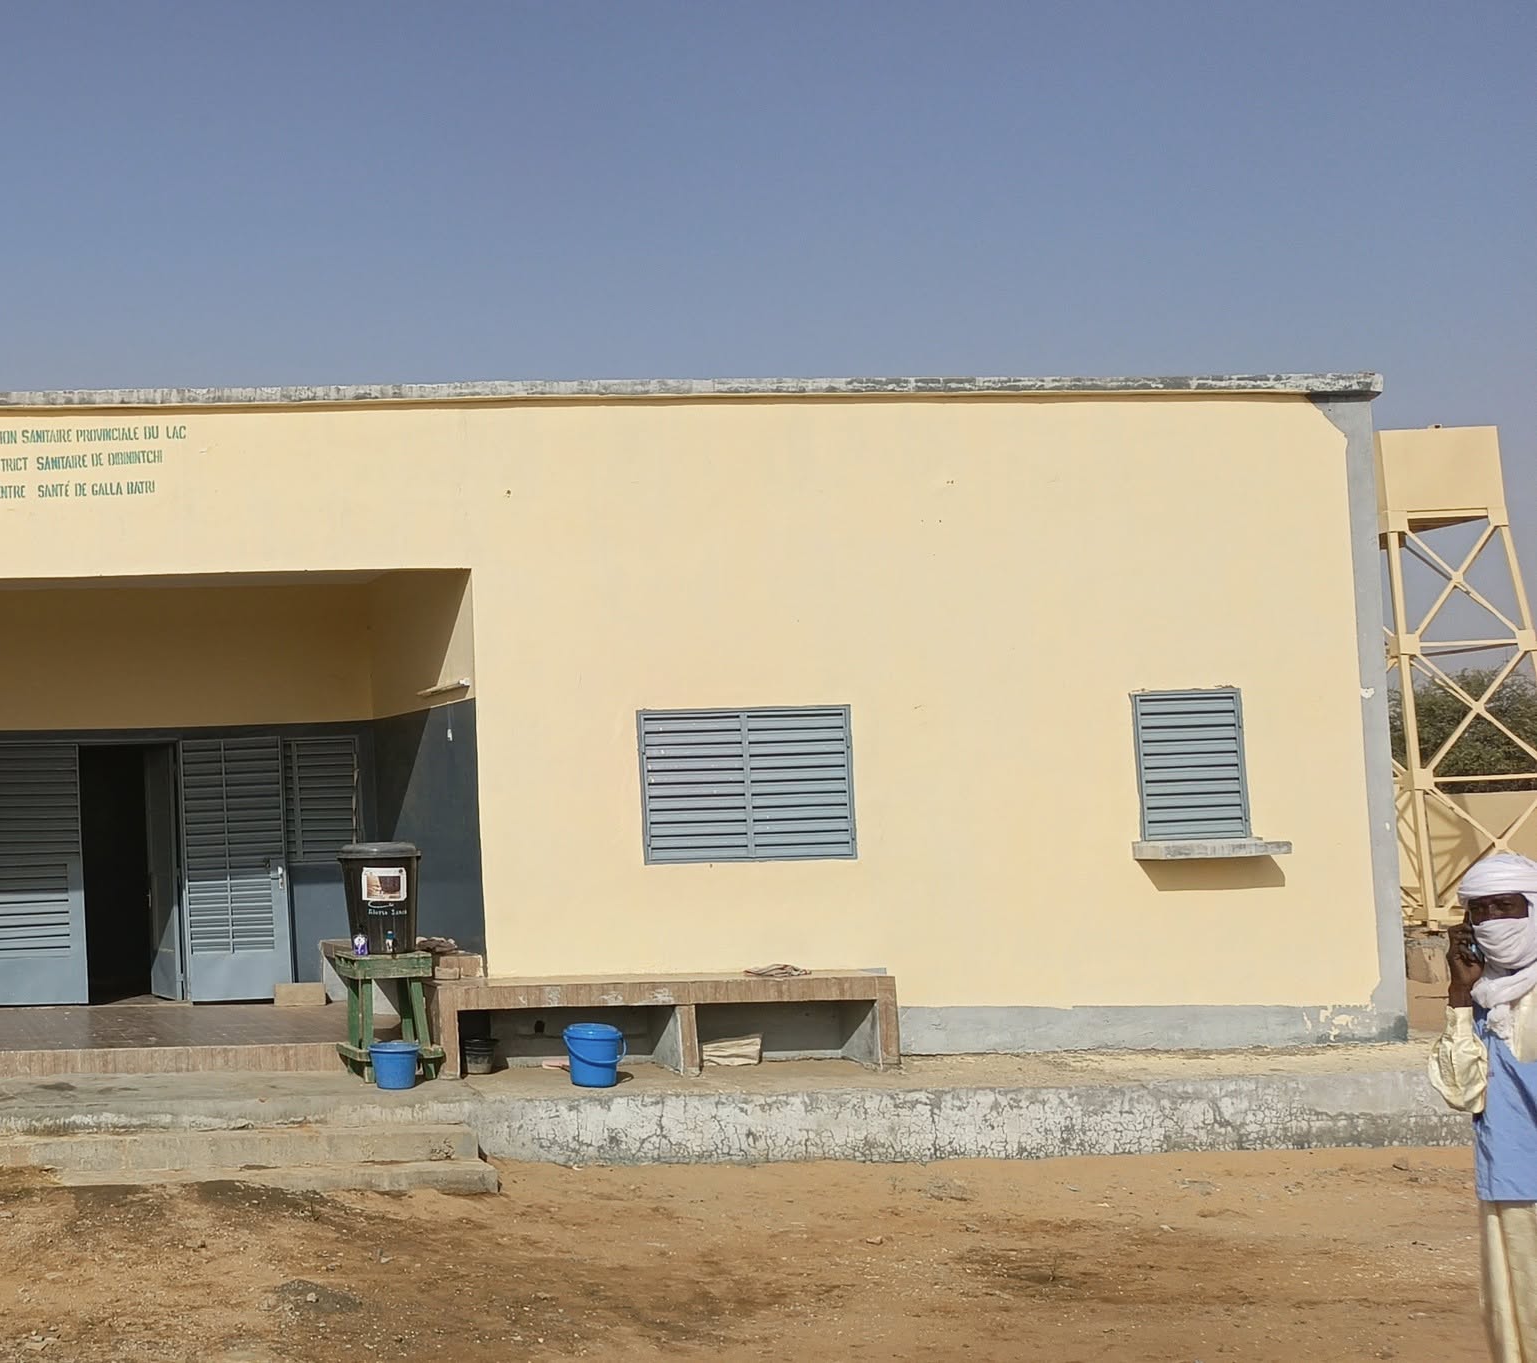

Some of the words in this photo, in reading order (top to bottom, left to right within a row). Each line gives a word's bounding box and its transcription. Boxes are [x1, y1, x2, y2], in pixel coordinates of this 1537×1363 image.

[21, 429, 72, 444] SANITAIRE
[76, 427, 140, 442] PROVINCIALE
[144, 425, 159, 440] DU
[166, 425, 187, 440] LAC
[36, 454, 88, 471] SANITAIRE
[91, 452, 103, 467] DE
[37, 480, 70, 498] SANTÉ
[74, 482, 87, 497] DE
[91, 481, 123, 496] GALLA
